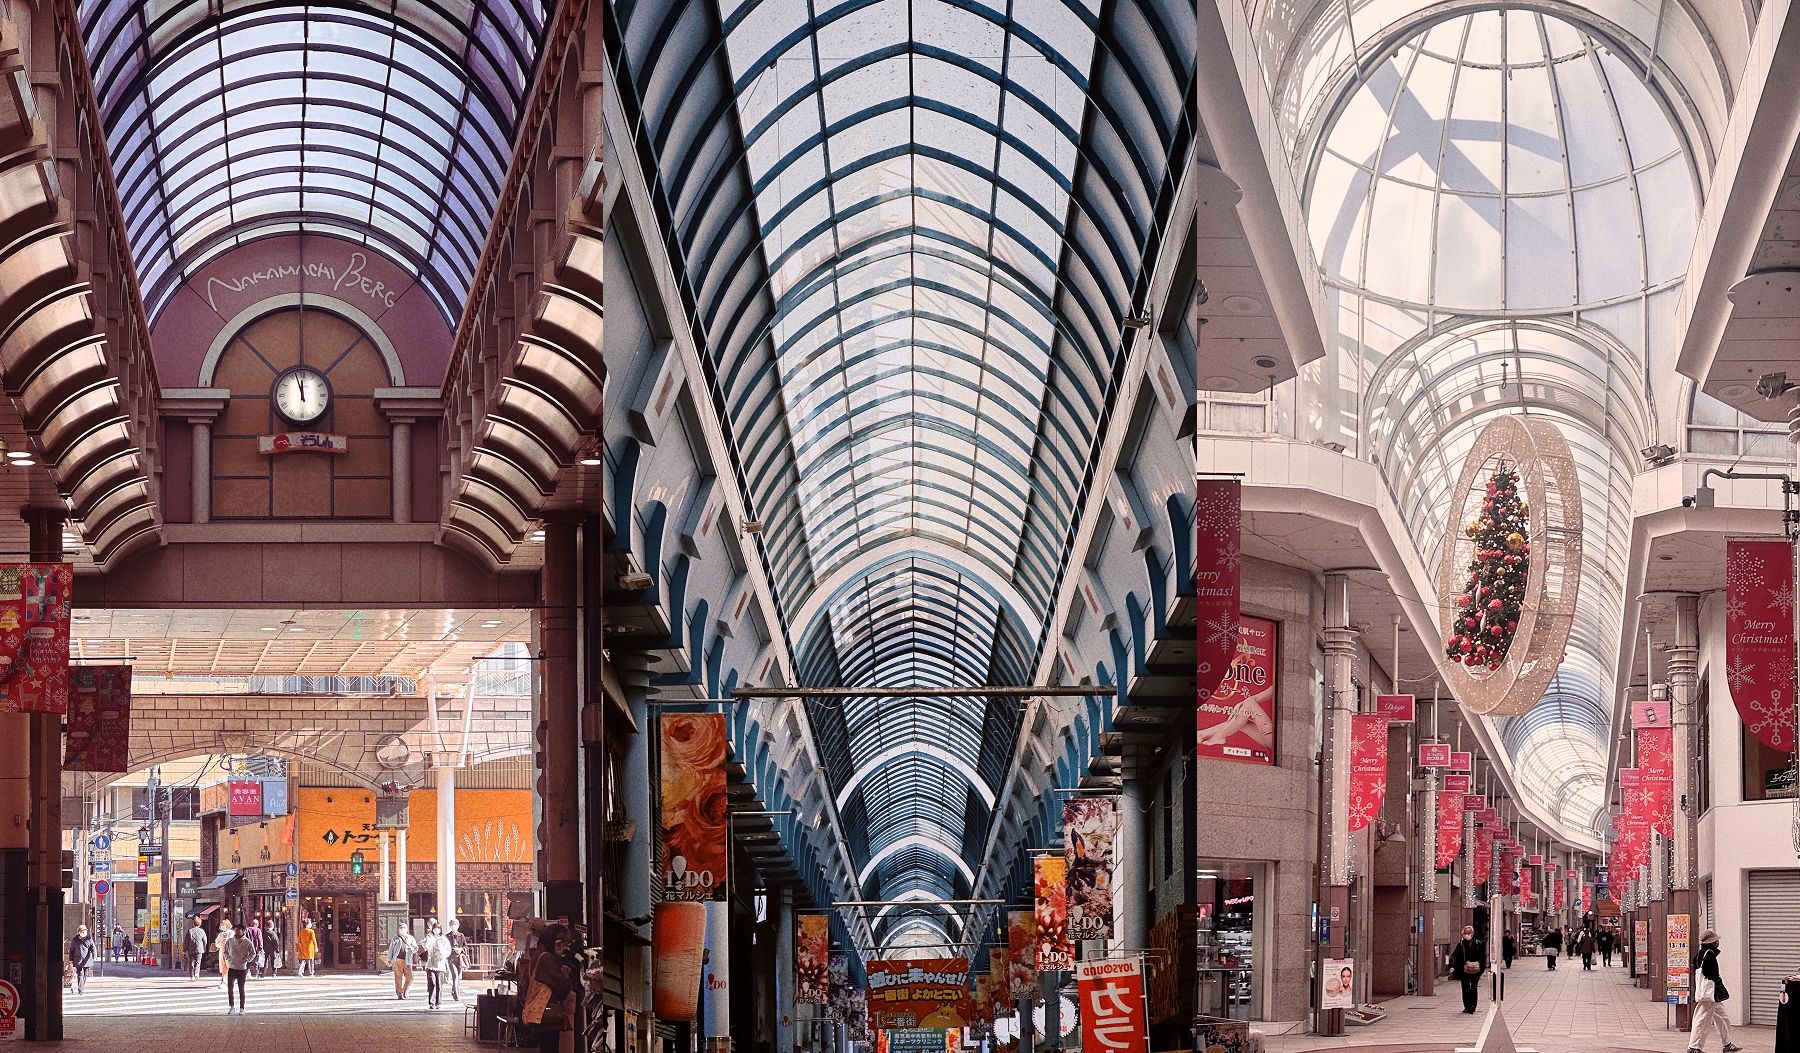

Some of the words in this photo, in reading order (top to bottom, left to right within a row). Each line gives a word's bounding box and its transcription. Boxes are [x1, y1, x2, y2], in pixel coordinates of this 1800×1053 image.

[207, 263, 336, 312] NAKAMACHI
[334, 252, 395, 308] BERG
[300, 434, 333, 448] そうしん
[1197, 568, 1220, 583] erry
[1744, 619, 1776, 633] Merry
[1732, 633, 1788, 645] Christmas!
[1360, 757, 1378, 766] Merry
[1648, 767, 1665, 775] Merry
[1641, 774, 1671, 782] Christmas!
[231, 795, 260, 803] AVAN
[665, 890, 714, 901] 花マルシェ
[1067, 930, 1105, 939] 花マルシェ
